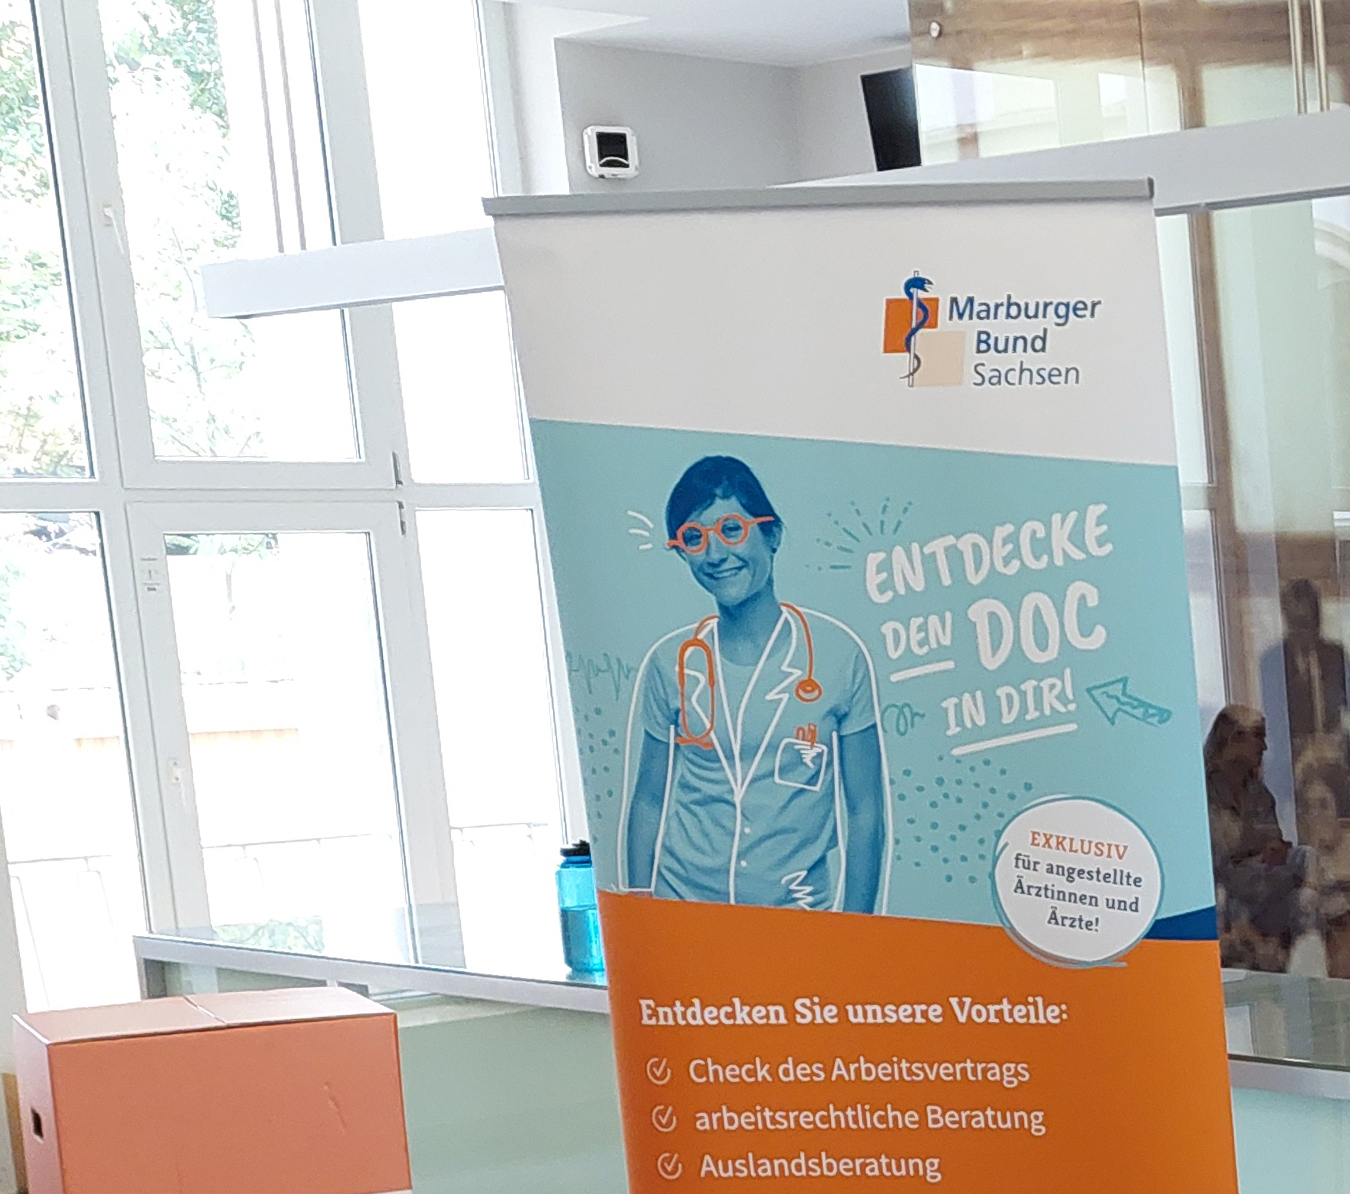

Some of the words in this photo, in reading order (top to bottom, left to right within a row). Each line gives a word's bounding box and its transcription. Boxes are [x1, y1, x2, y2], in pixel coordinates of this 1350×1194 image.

[948, 294, 1102, 327] Marburger
[975, 327, 1048, 354] Bund
[973, 360, 1080, 386] Sachsen
[865, 503, 1114, 604] ENTDECKE
[880, 610, 952, 660] DEN
[967, 580, 1107, 671] DOC
[941, 690, 986, 737] IN
[996, 667, 1077, 724] DIR!
[1030, 830, 1129, 861] EXKLUSIV
[1013, 853, 1041, 872] für
[1045, 863, 1143, 888] angestellte
[1013, 875, 1100, 907] Ärztinnen
[1105, 896, 1140, 913] und
[1047, 906, 1100, 932] Ärzte!
[640, 998, 787, 1026] Entdecken
[795, 997, 838, 1024] Sie
[847, 1002, 943, 1024] unsere
[949, 996, 1069, 1025] Vorteile:
[688, 1057, 773, 1083] Check
[777, 1057, 824, 1082] des
[832, 1056, 1031, 1088] Arbeitsvertrags
[695, 1104, 919, 1131] arbeitsrechtliche
[927, 1104, 1047, 1136] Beratung
[700, 1152, 941, 1183] Auslandsberatung
